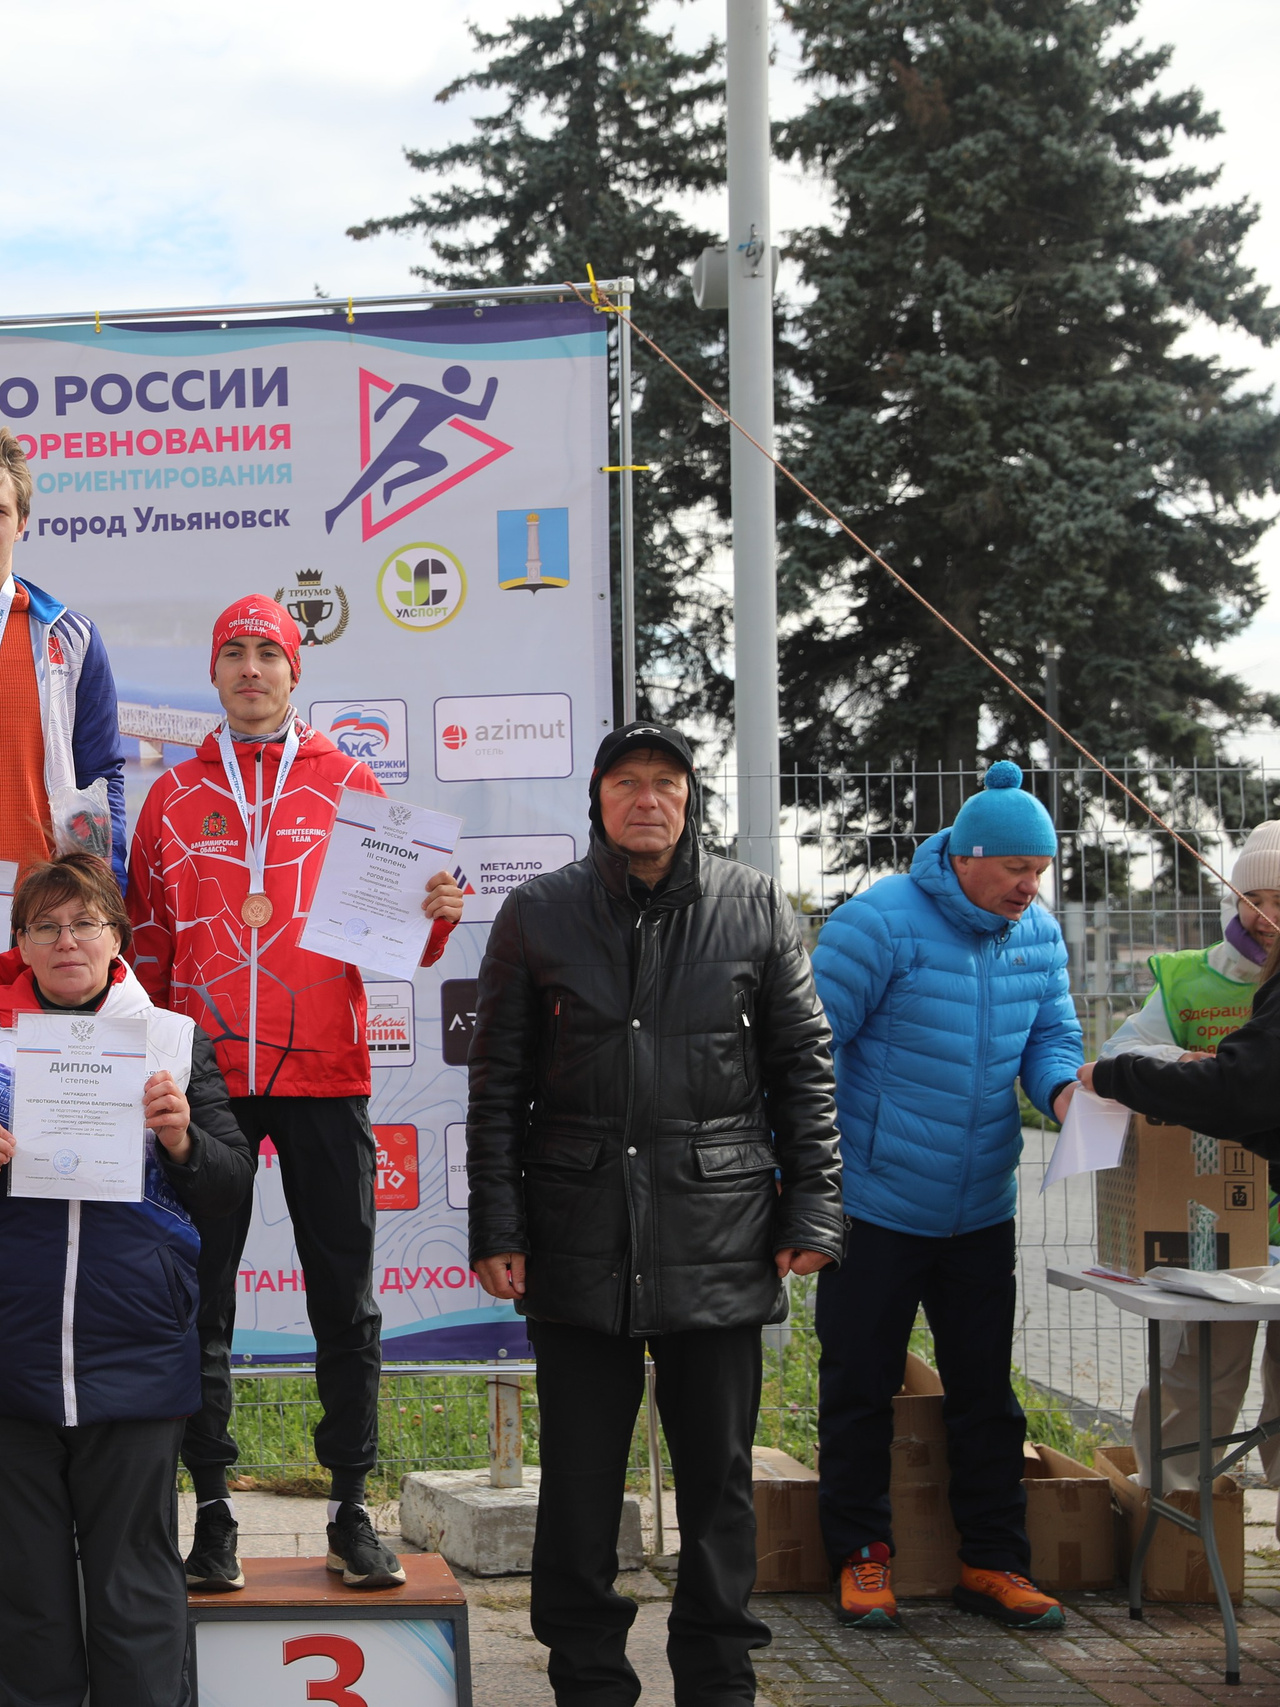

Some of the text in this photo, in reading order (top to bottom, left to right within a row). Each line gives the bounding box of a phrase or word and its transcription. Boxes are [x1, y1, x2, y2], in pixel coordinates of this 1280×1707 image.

[54, 366, 289, 416] РОССИИ
[14, 423, 292, 460] ОРЕВНОВАНИЯ
[36, 462, 293, 494] ОРИЕНТИРОВАНИЯ
[37, 514, 127, 543] город
[133, 506, 291, 534] Ульяновск
[288, 587, 332, 599] ТРИУМФ
[395, 607, 449, 618] УЛСПОРТ
[228, 618, 281, 634] ORIENTEERING
[244, 625, 266, 633] TEAM
[475, 718, 566, 741] azimut
[475, 748, 504, 756] ОТЕЛЬ
[366, 760, 406, 770] ДЕРЖКИ
[275, 828, 327, 837] ORIENTEERING
[190, 839, 239, 850] ВЛАДИМИРСКАЯ
[291, 835, 312, 843] TEAM
[199, 846, 227, 854] ОБЛАСТЬ
[360, 837, 419, 862] ДИПЛОМ
[375, 855, 407, 869] степень
[480, 861, 543, 872] МЕТАЛЛО
[480, 873, 539, 883] ПРОФИЛ
[480, 886, 514, 895] ЗАВО
[49, 1062, 112, 1074] ДИПЛОМ
[65, 1077, 100, 1085] степень
[1153, 1241, 1169, 1262] L
[282, 1633, 369, 1707] 3
